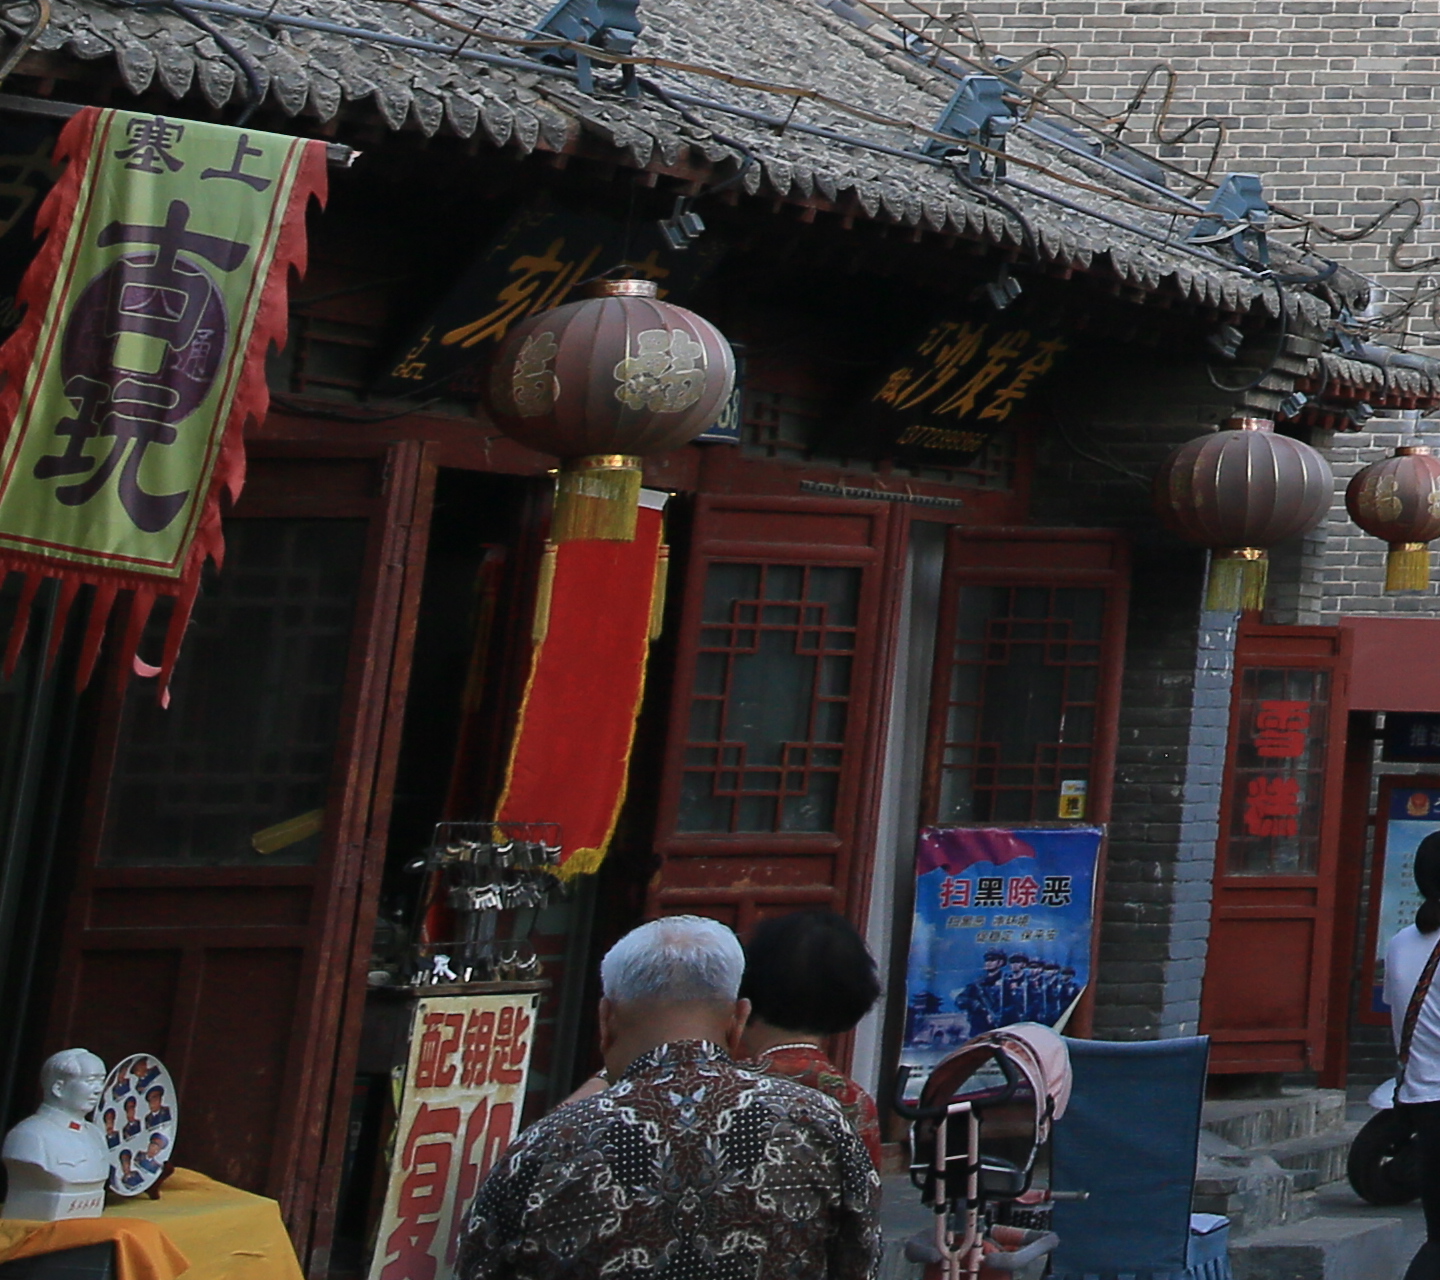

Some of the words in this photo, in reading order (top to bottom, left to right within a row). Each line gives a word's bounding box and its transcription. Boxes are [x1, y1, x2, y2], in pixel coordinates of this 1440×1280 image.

[113, 116, 273, 193] 塞上
[33, 198, 251, 533] 古玩
[939, 875, 1073, 908] 扫黑除恶
[415, 1006, 531, 1089] 配钥匙
